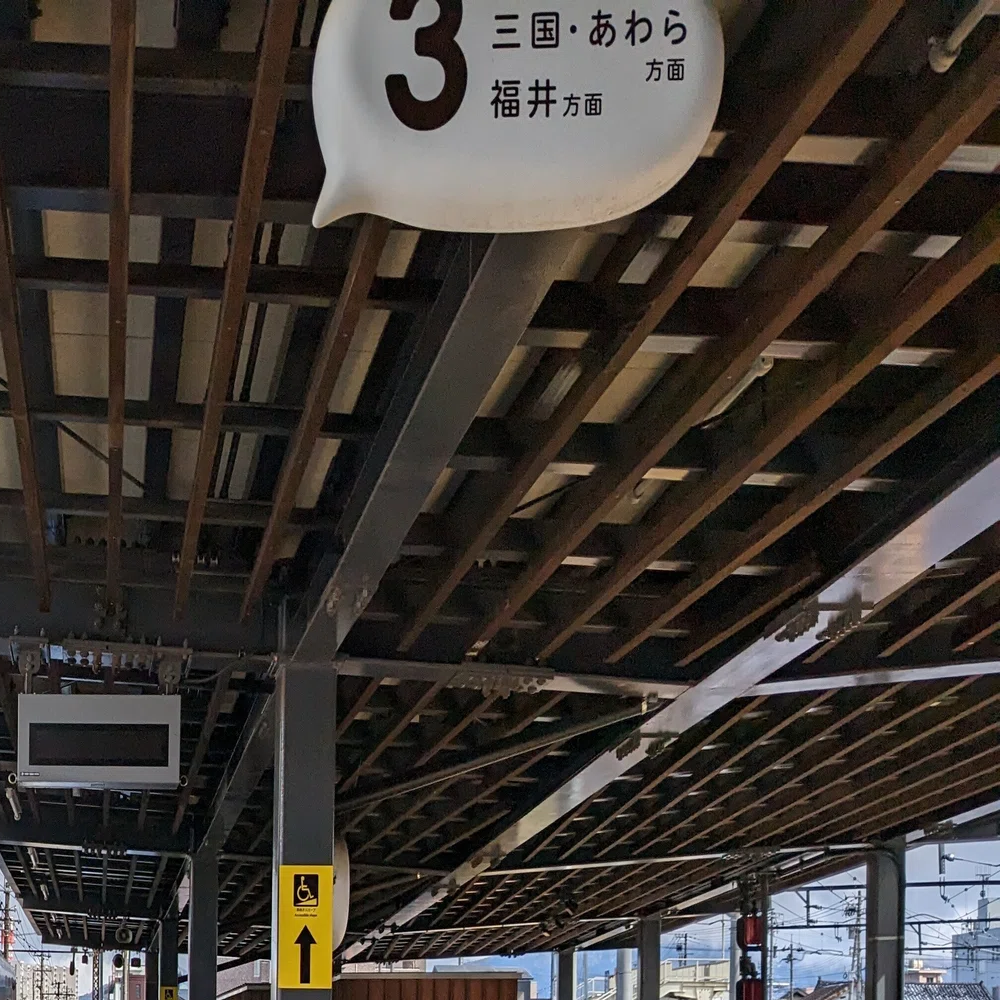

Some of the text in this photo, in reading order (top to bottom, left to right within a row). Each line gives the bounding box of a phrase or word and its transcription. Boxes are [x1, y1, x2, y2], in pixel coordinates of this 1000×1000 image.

[492, 9, 688, 50] 三国・あわら
[385, 0, 468, 131] 3
[646, 58, 685, 82] 方面
